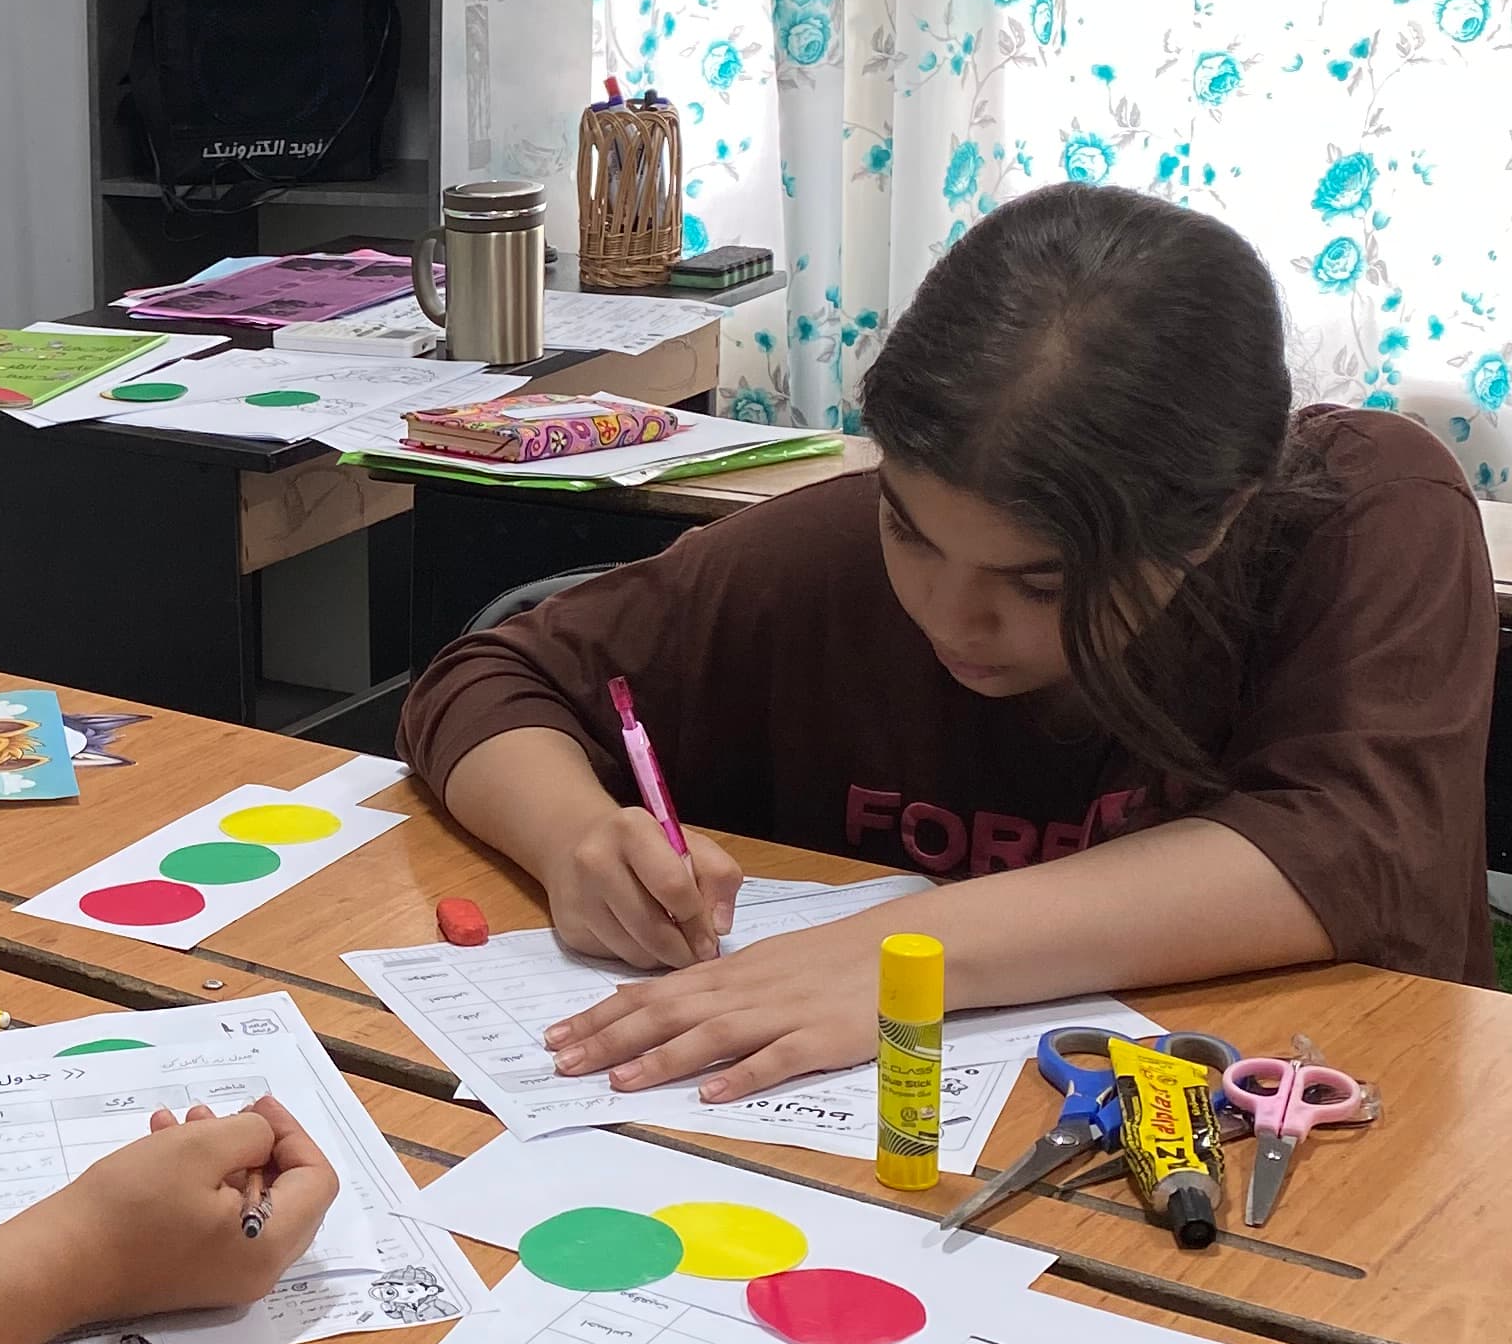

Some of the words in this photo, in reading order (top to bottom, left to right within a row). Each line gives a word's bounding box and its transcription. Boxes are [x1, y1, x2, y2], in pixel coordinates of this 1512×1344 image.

[203, 139, 286, 160] الکترونیک
[289, 138, 324, 159] نوید
[774, 1102, 854, 1122] ارتباط
[580, 1319, 633, 1337] احساس
